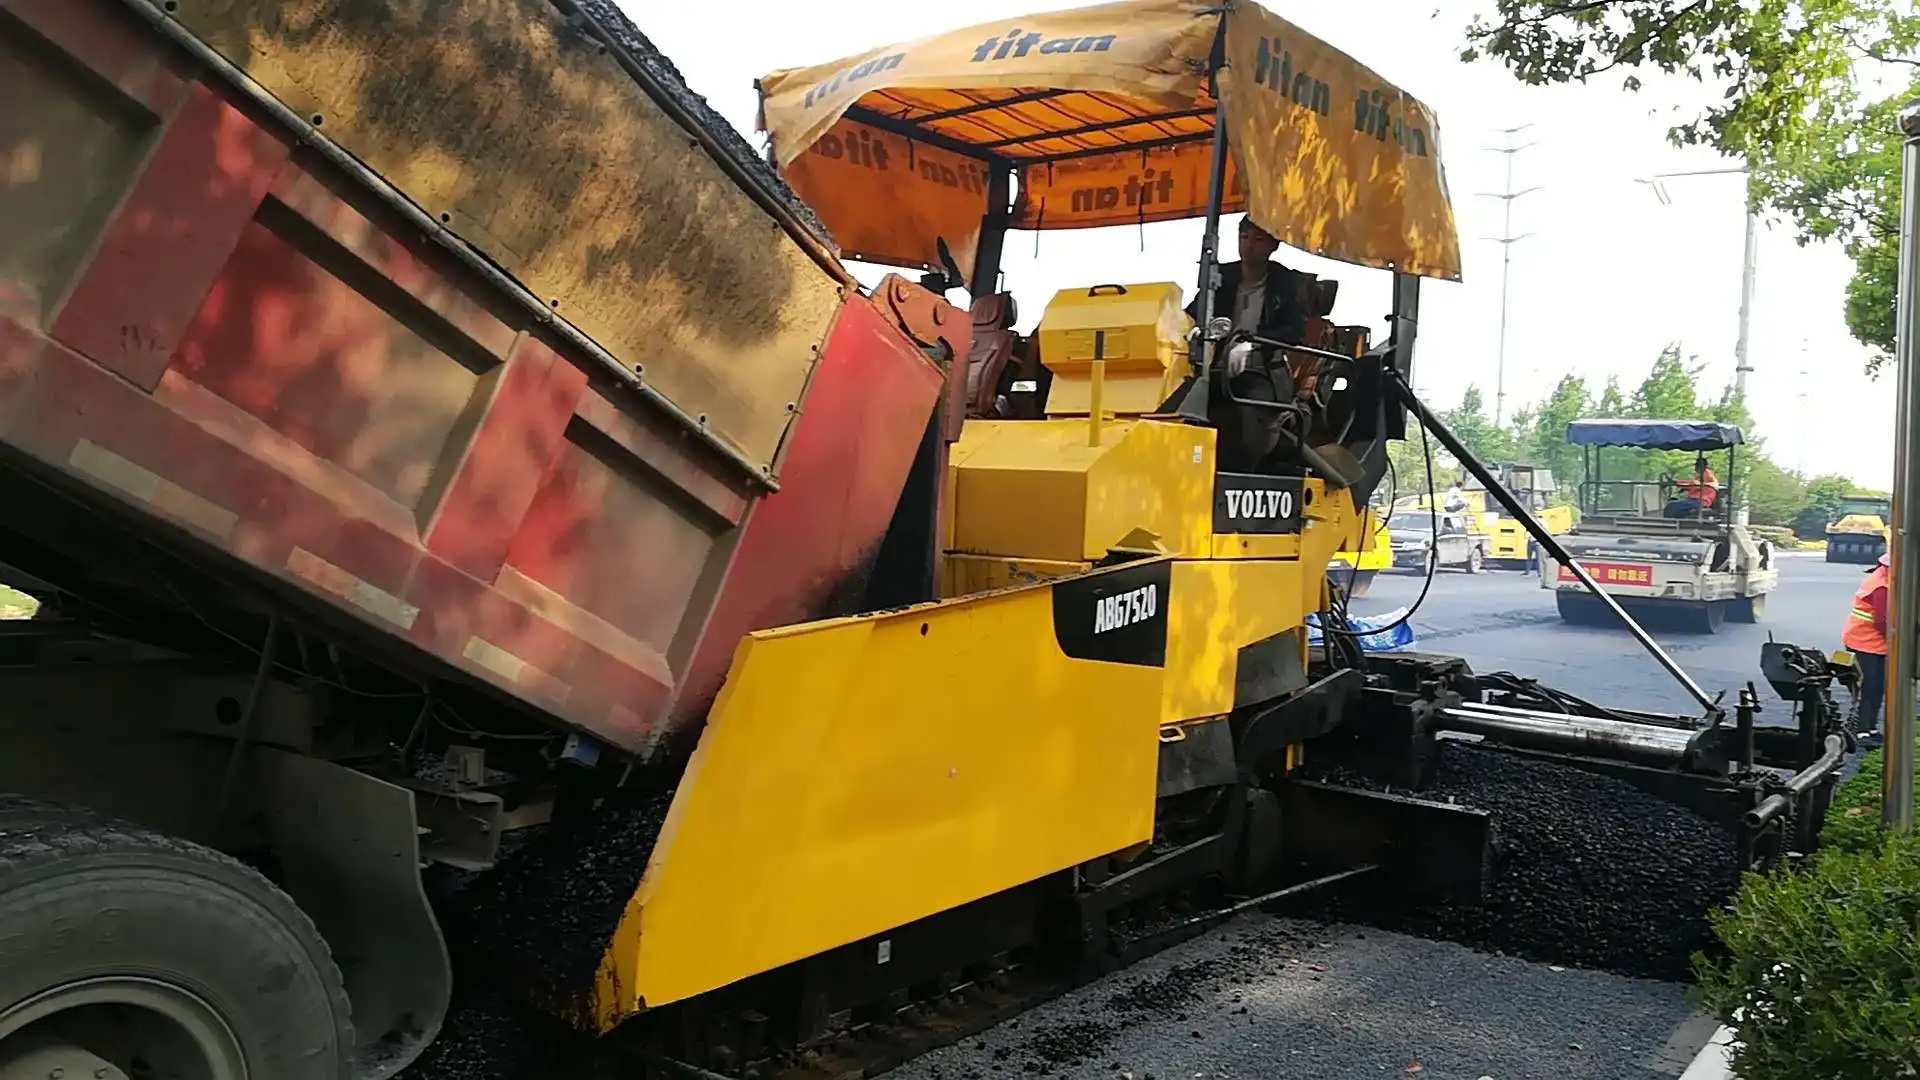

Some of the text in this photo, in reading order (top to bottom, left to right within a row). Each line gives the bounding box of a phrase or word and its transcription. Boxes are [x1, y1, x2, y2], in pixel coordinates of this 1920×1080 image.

[970, 28, 1117, 63] titan
[1255, 36, 1330, 117] titan
[1225, 489, 1293, 519] VOLVO
[1094, 583, 1157, 634] ABG7520
